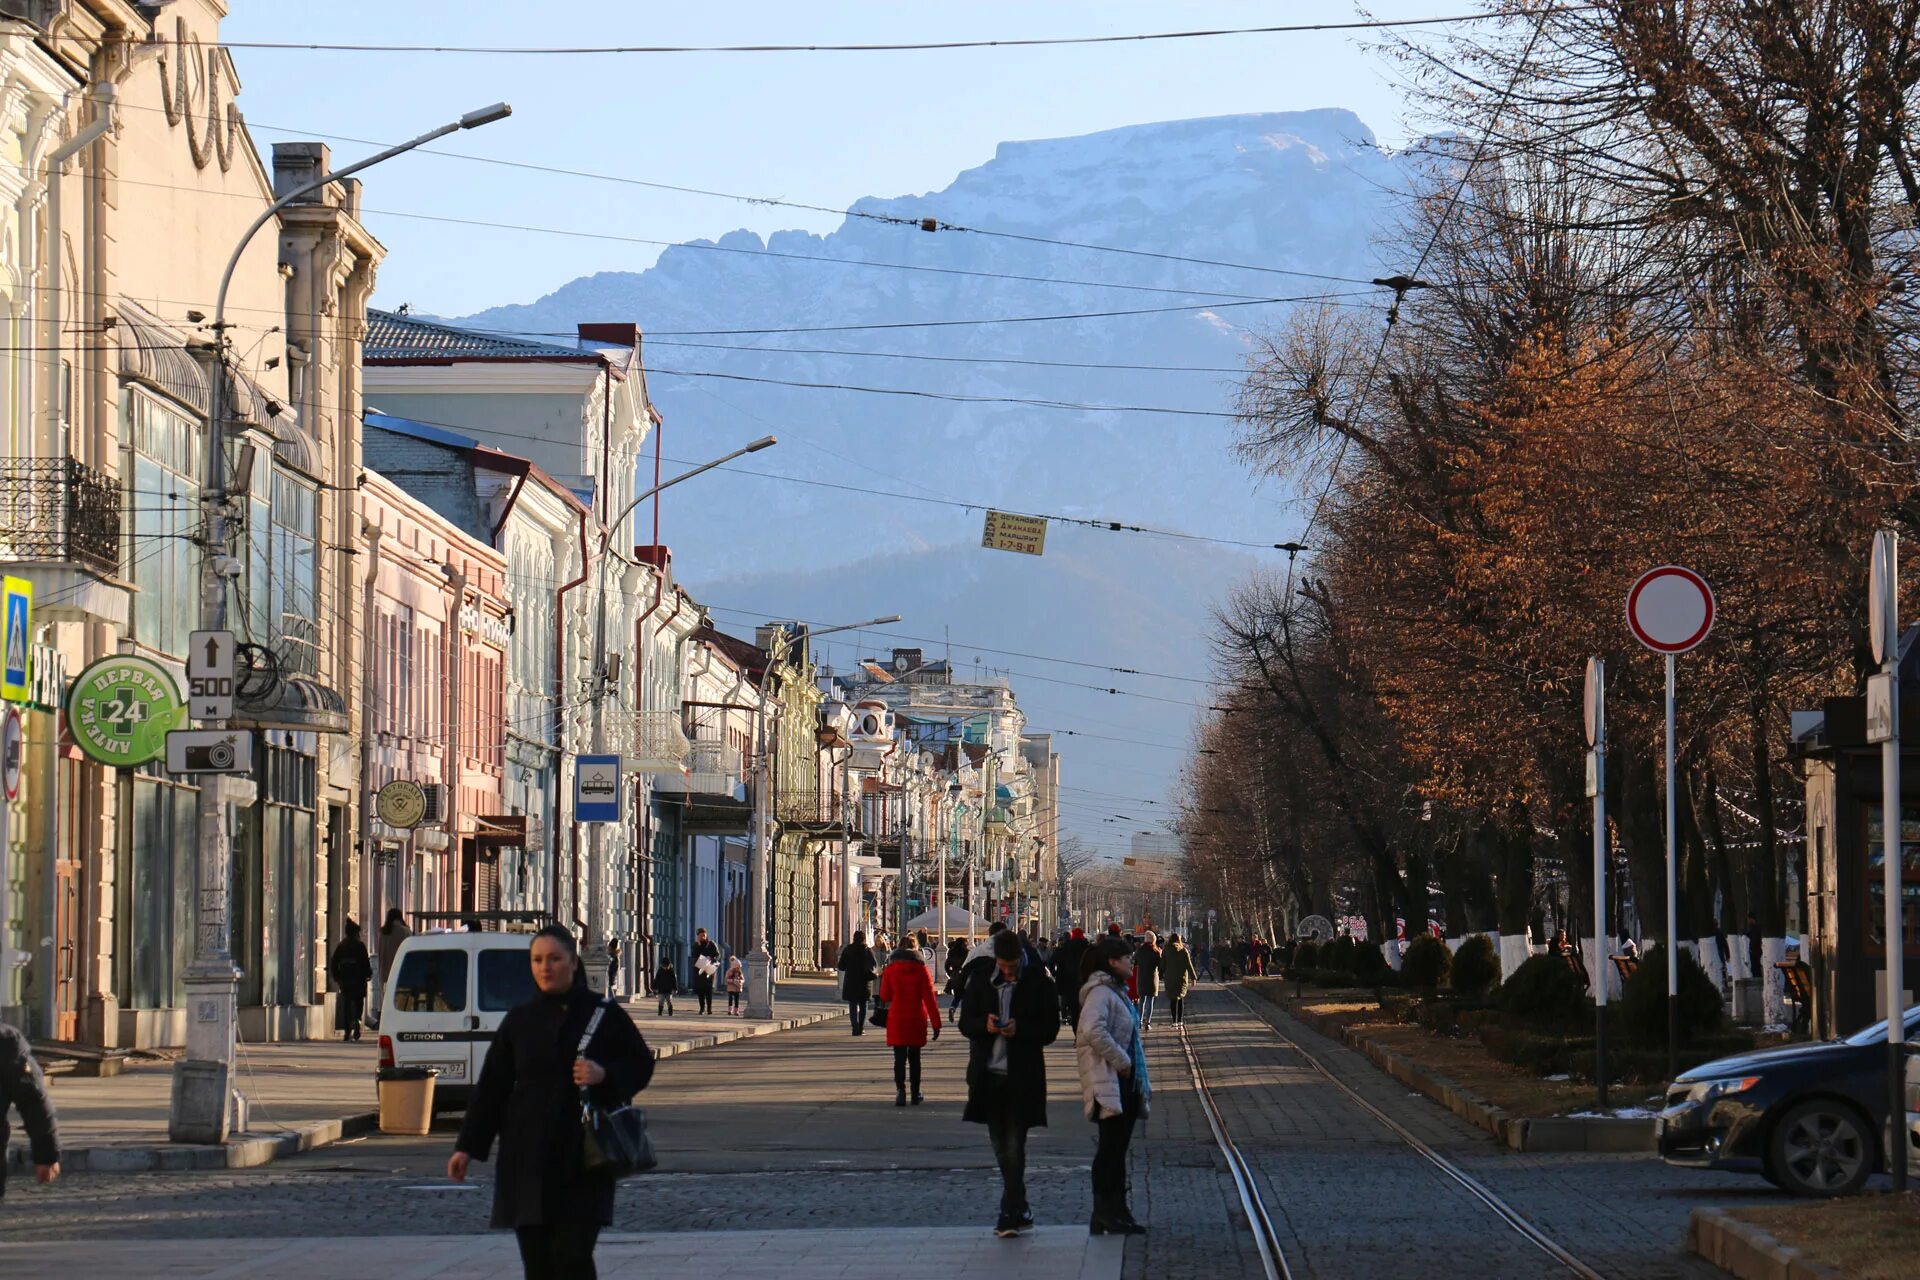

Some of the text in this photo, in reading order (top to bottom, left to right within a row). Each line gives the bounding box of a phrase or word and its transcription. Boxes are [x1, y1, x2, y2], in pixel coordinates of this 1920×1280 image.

[92, 669, 165, 702] ПЕРВАЯ
[190, 677, 232, 697] 500
[107, 700, 142, 723] 24
[81, 697, 131, 755] АПТЕКА
